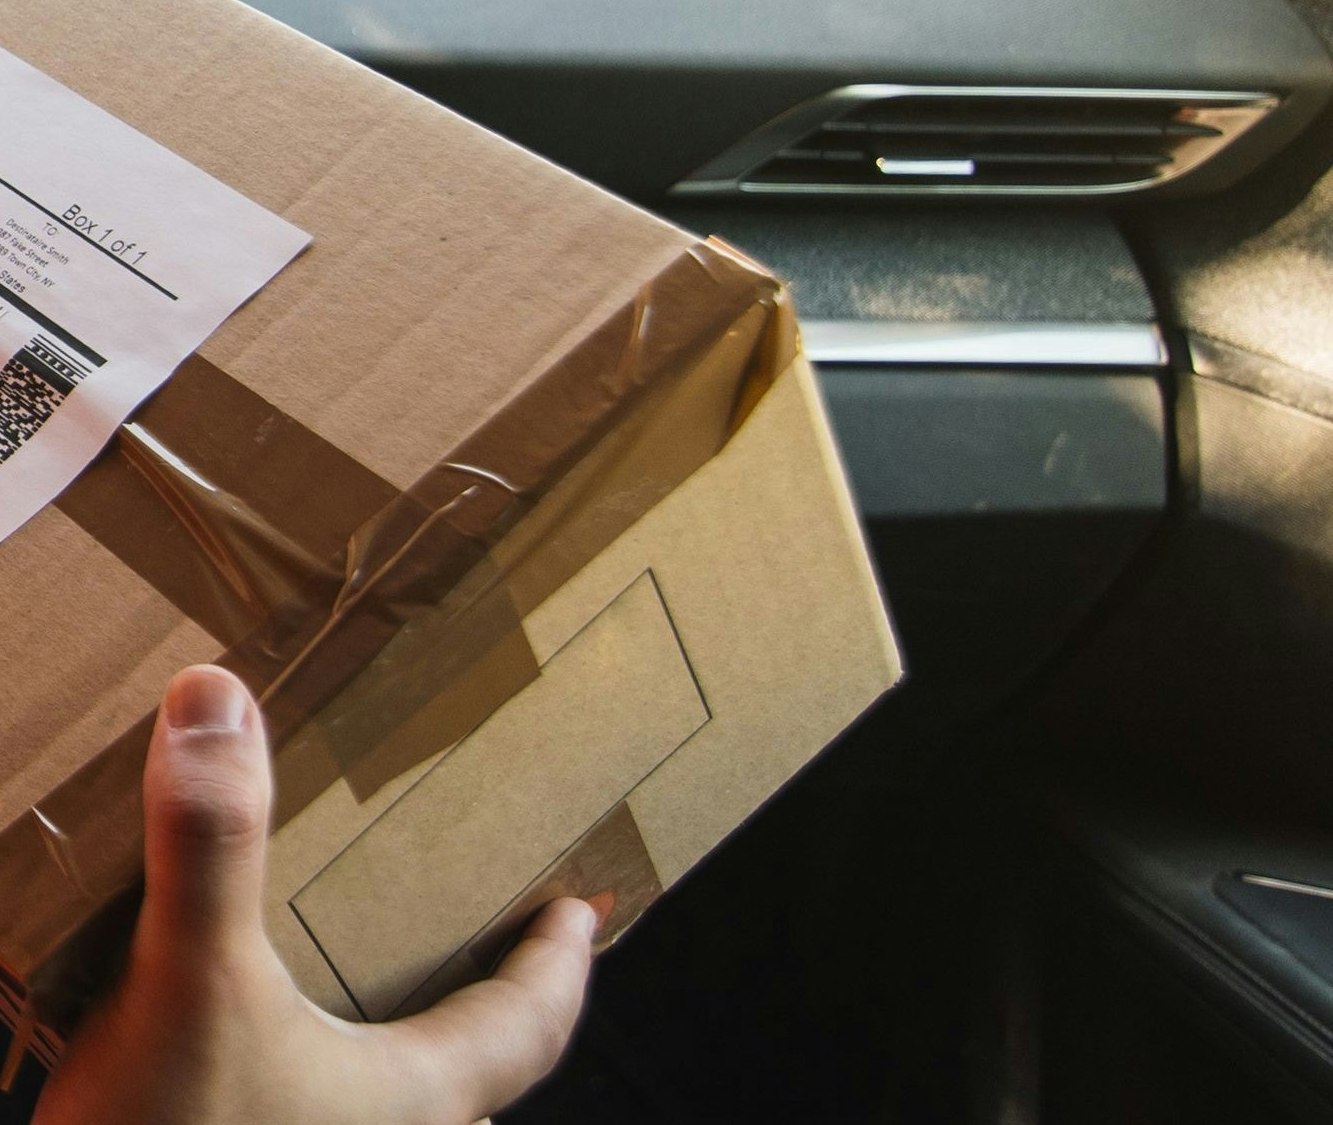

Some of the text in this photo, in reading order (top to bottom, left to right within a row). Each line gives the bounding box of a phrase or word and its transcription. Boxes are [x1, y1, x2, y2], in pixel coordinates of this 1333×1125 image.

[5, 218, 71, 266] Destinataire Smith
[9, 238, 26, 253] Fake
[24, 249, 49, 268] Street
[61, 204, 148, 265] Box 1 of 1
[7, 250, 26, 269] Town
[25, 261, 41, 281] City,
[41, 276, 55, 288] NY
